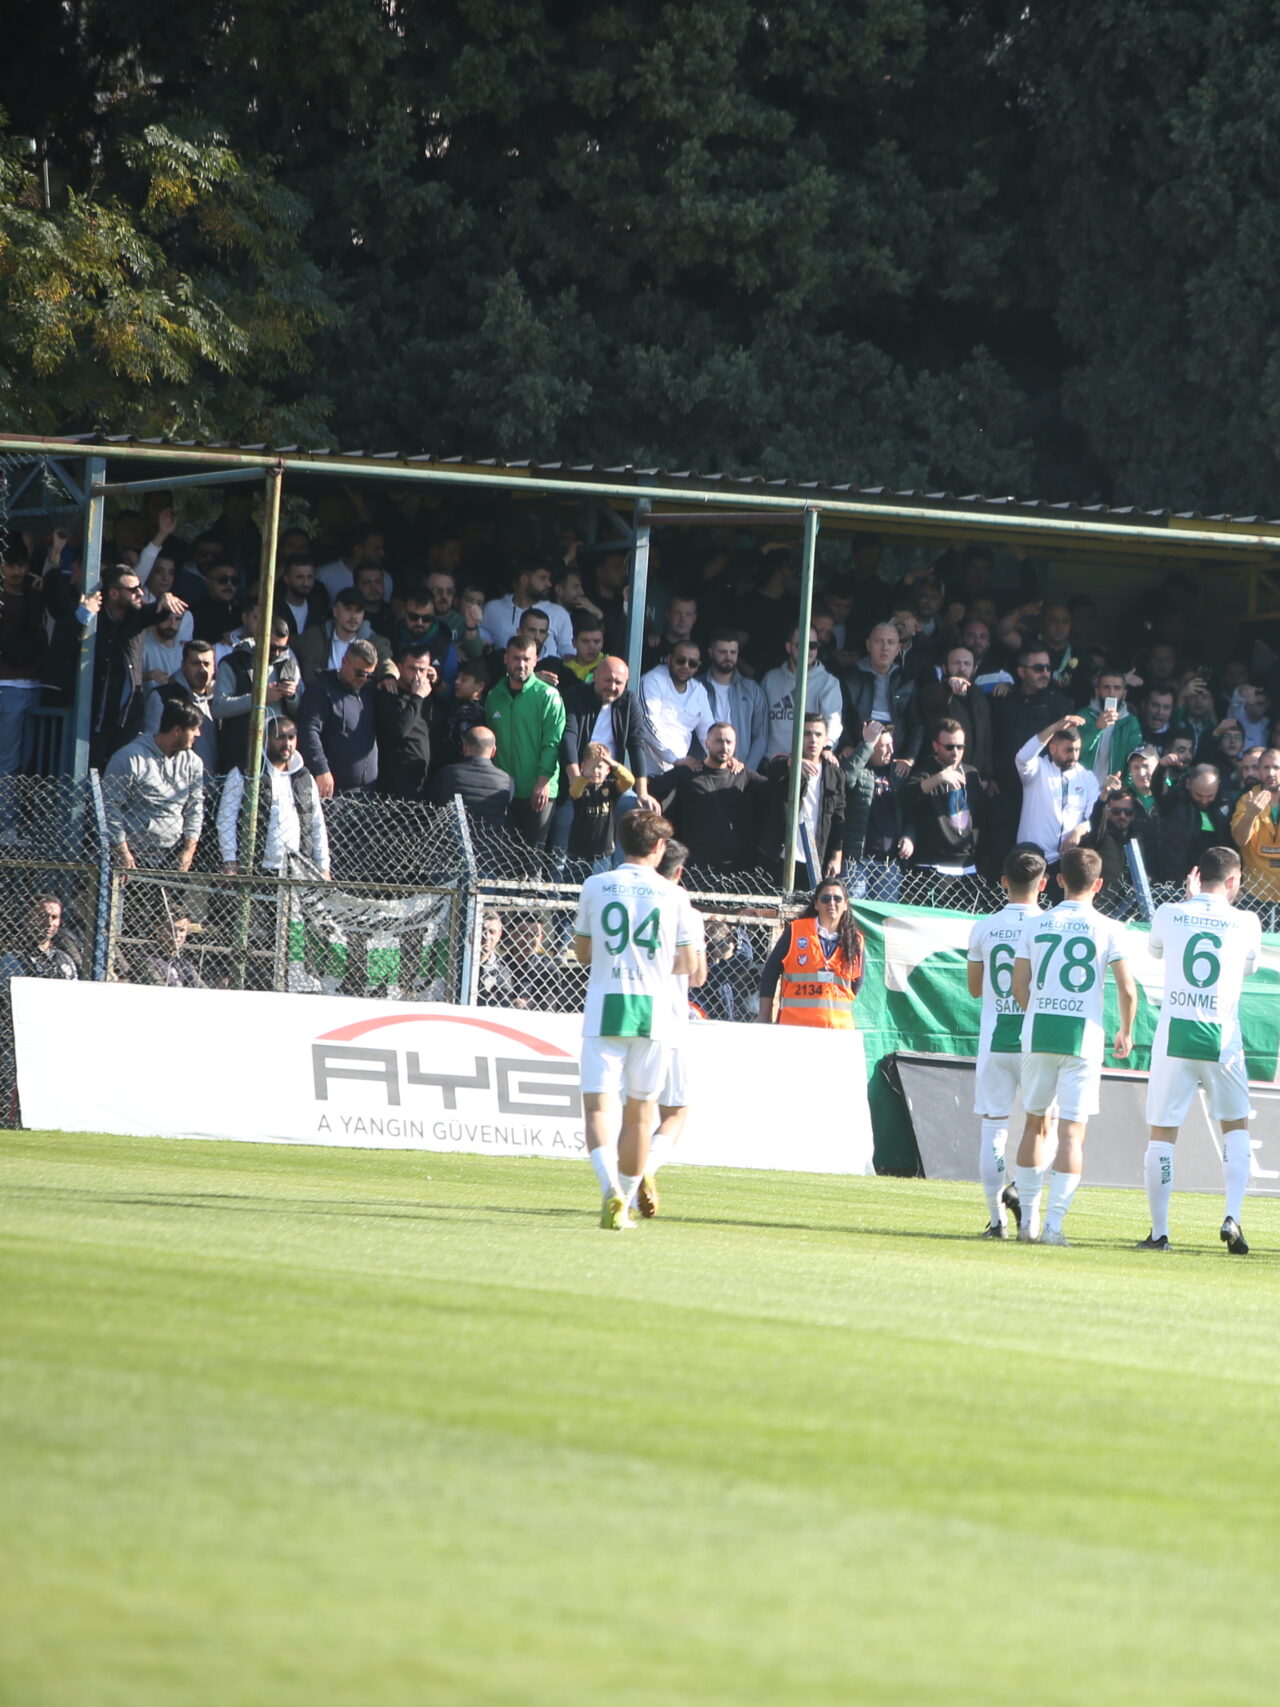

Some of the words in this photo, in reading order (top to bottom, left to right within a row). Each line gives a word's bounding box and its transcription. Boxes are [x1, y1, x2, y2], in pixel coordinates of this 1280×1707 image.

[600, 901, 662, 960] 94
[989, 943, 1016, 999] 6
[1034, 933, 1097, 993] 78
[1182, 931, 1223, 989] 6
[794, 984, 823, 996] 2134
[311, 1043, 583, 1119] AYG
[317, 1113, 332, 1132] A
[340, 1114, 424, 1139] YANGIN
[432, 1118, 543, 1147] GÜVENLİK
